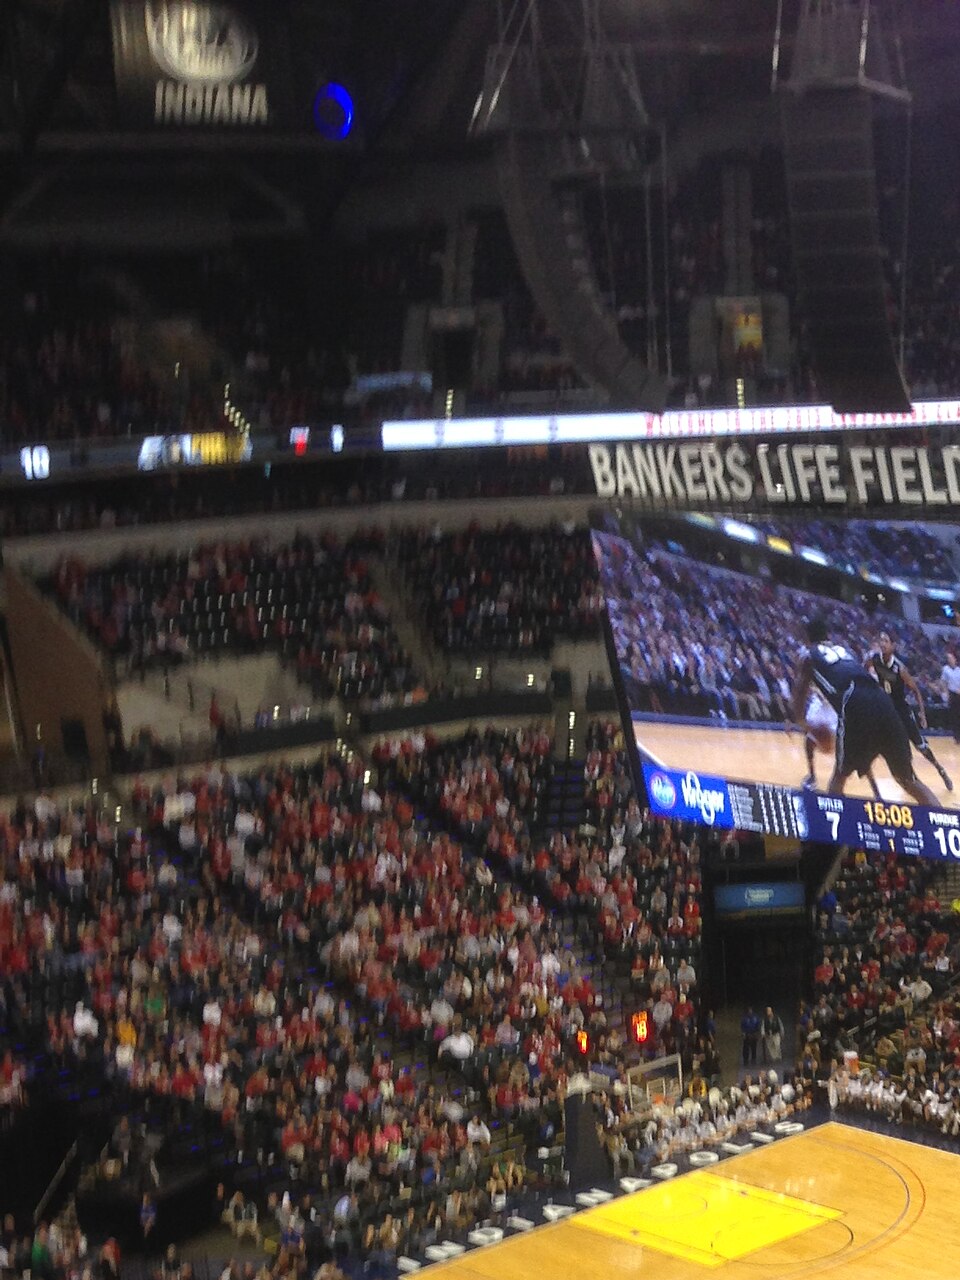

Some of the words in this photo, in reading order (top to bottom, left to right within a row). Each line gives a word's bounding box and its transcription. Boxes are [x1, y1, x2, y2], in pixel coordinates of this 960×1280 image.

[154, 80, 268, 124] INDIANA
[588, 441, 754, 501] BANKERS
[756, 443, 848, 503] LIFE
[681, 771, 725, 825] Kroger
[817, 796, 844, 812] BUTLER
[825, 810, 841, 841] 7
[863, 800, 914, 829] 15:08
[928, 811, 960, 828] PURDUE
